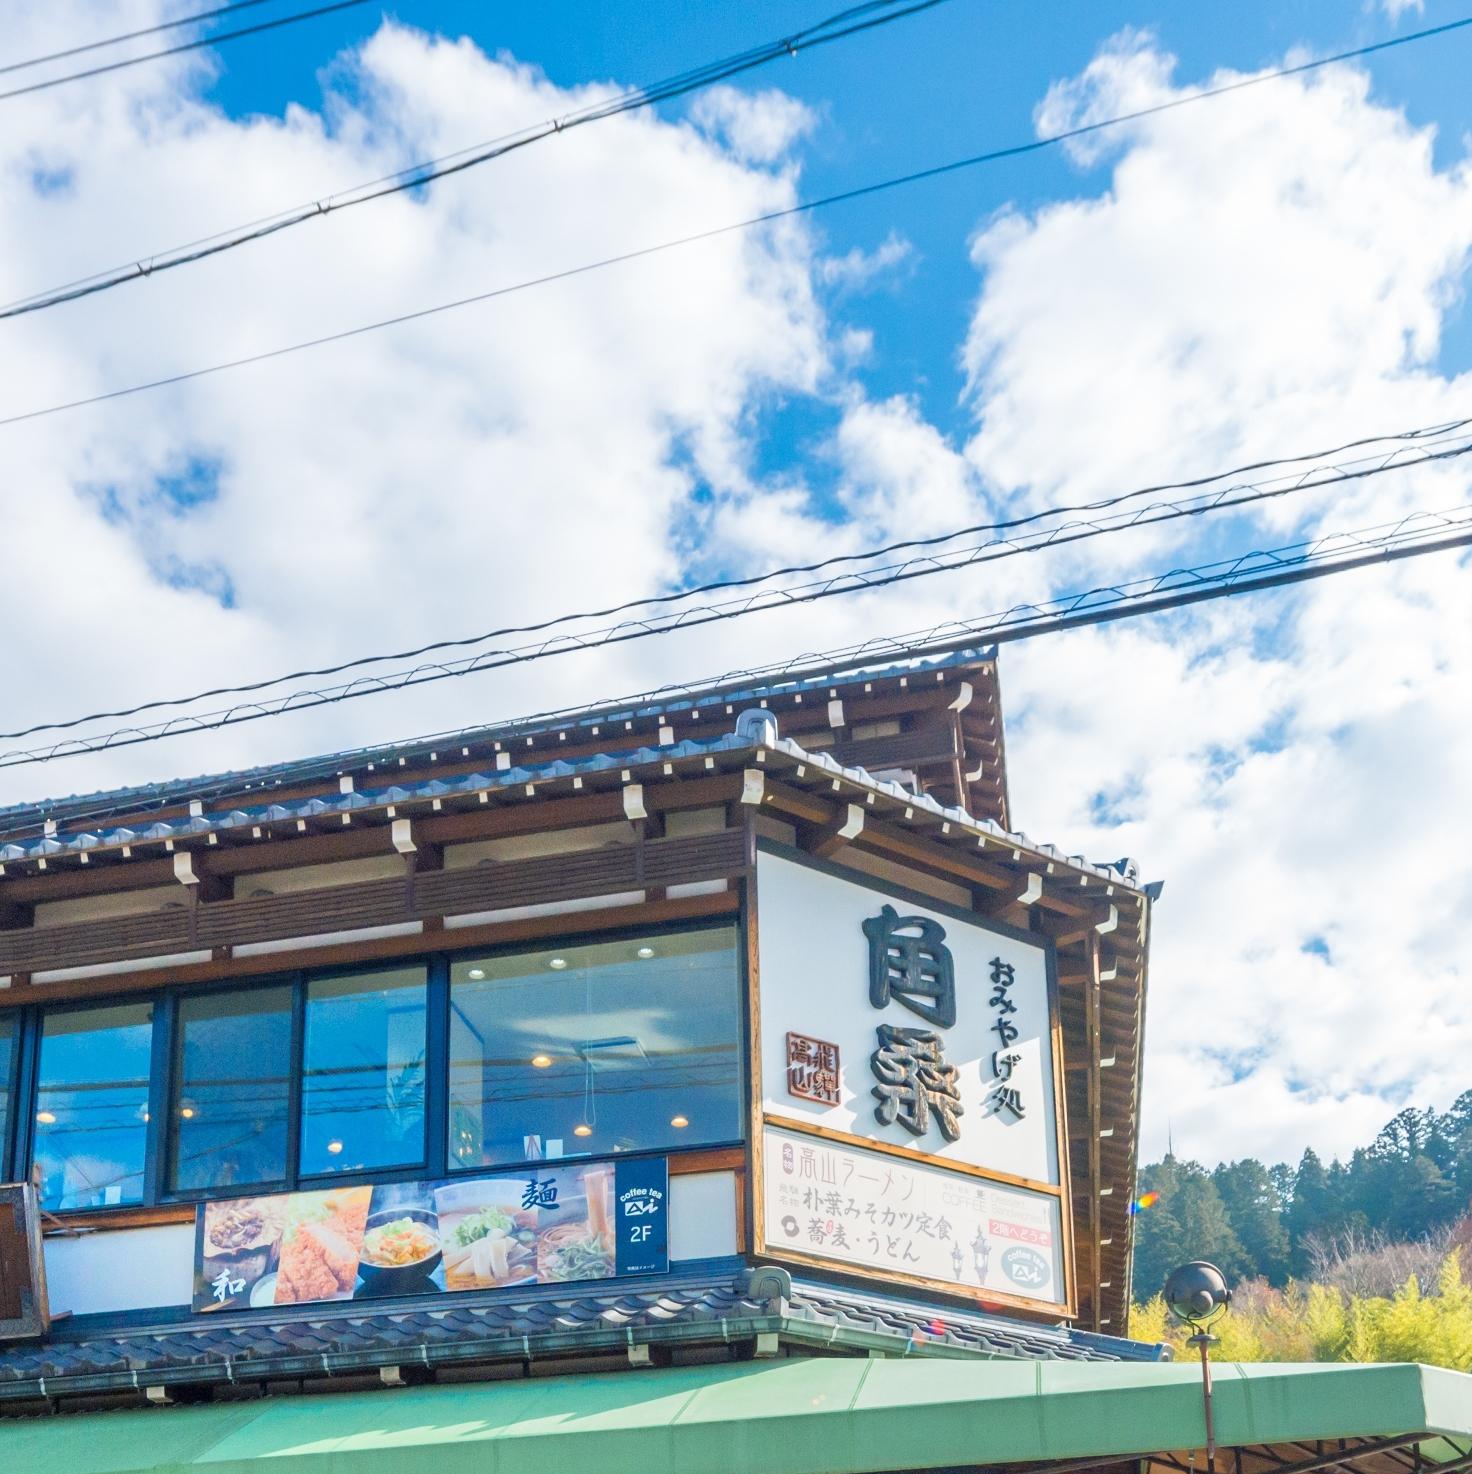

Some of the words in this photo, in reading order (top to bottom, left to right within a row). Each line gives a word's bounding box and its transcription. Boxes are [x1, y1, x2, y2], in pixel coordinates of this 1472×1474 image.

[988, 956, 1026, 1120] おみやげ処
[798, 1147, 915, 1201] 高山ラーメン
[620, 1188, 647, 1202] coffee
[649, 1188, 663, 1199] tea
[803, 1186, 953, 1242] 朴葉みそカツ定食
[631, 1225, 652, 1242] 2F
[992, 1221, 1050, 1244] 2階へどうぞ
[212, 1269, 246, 1303] 和
